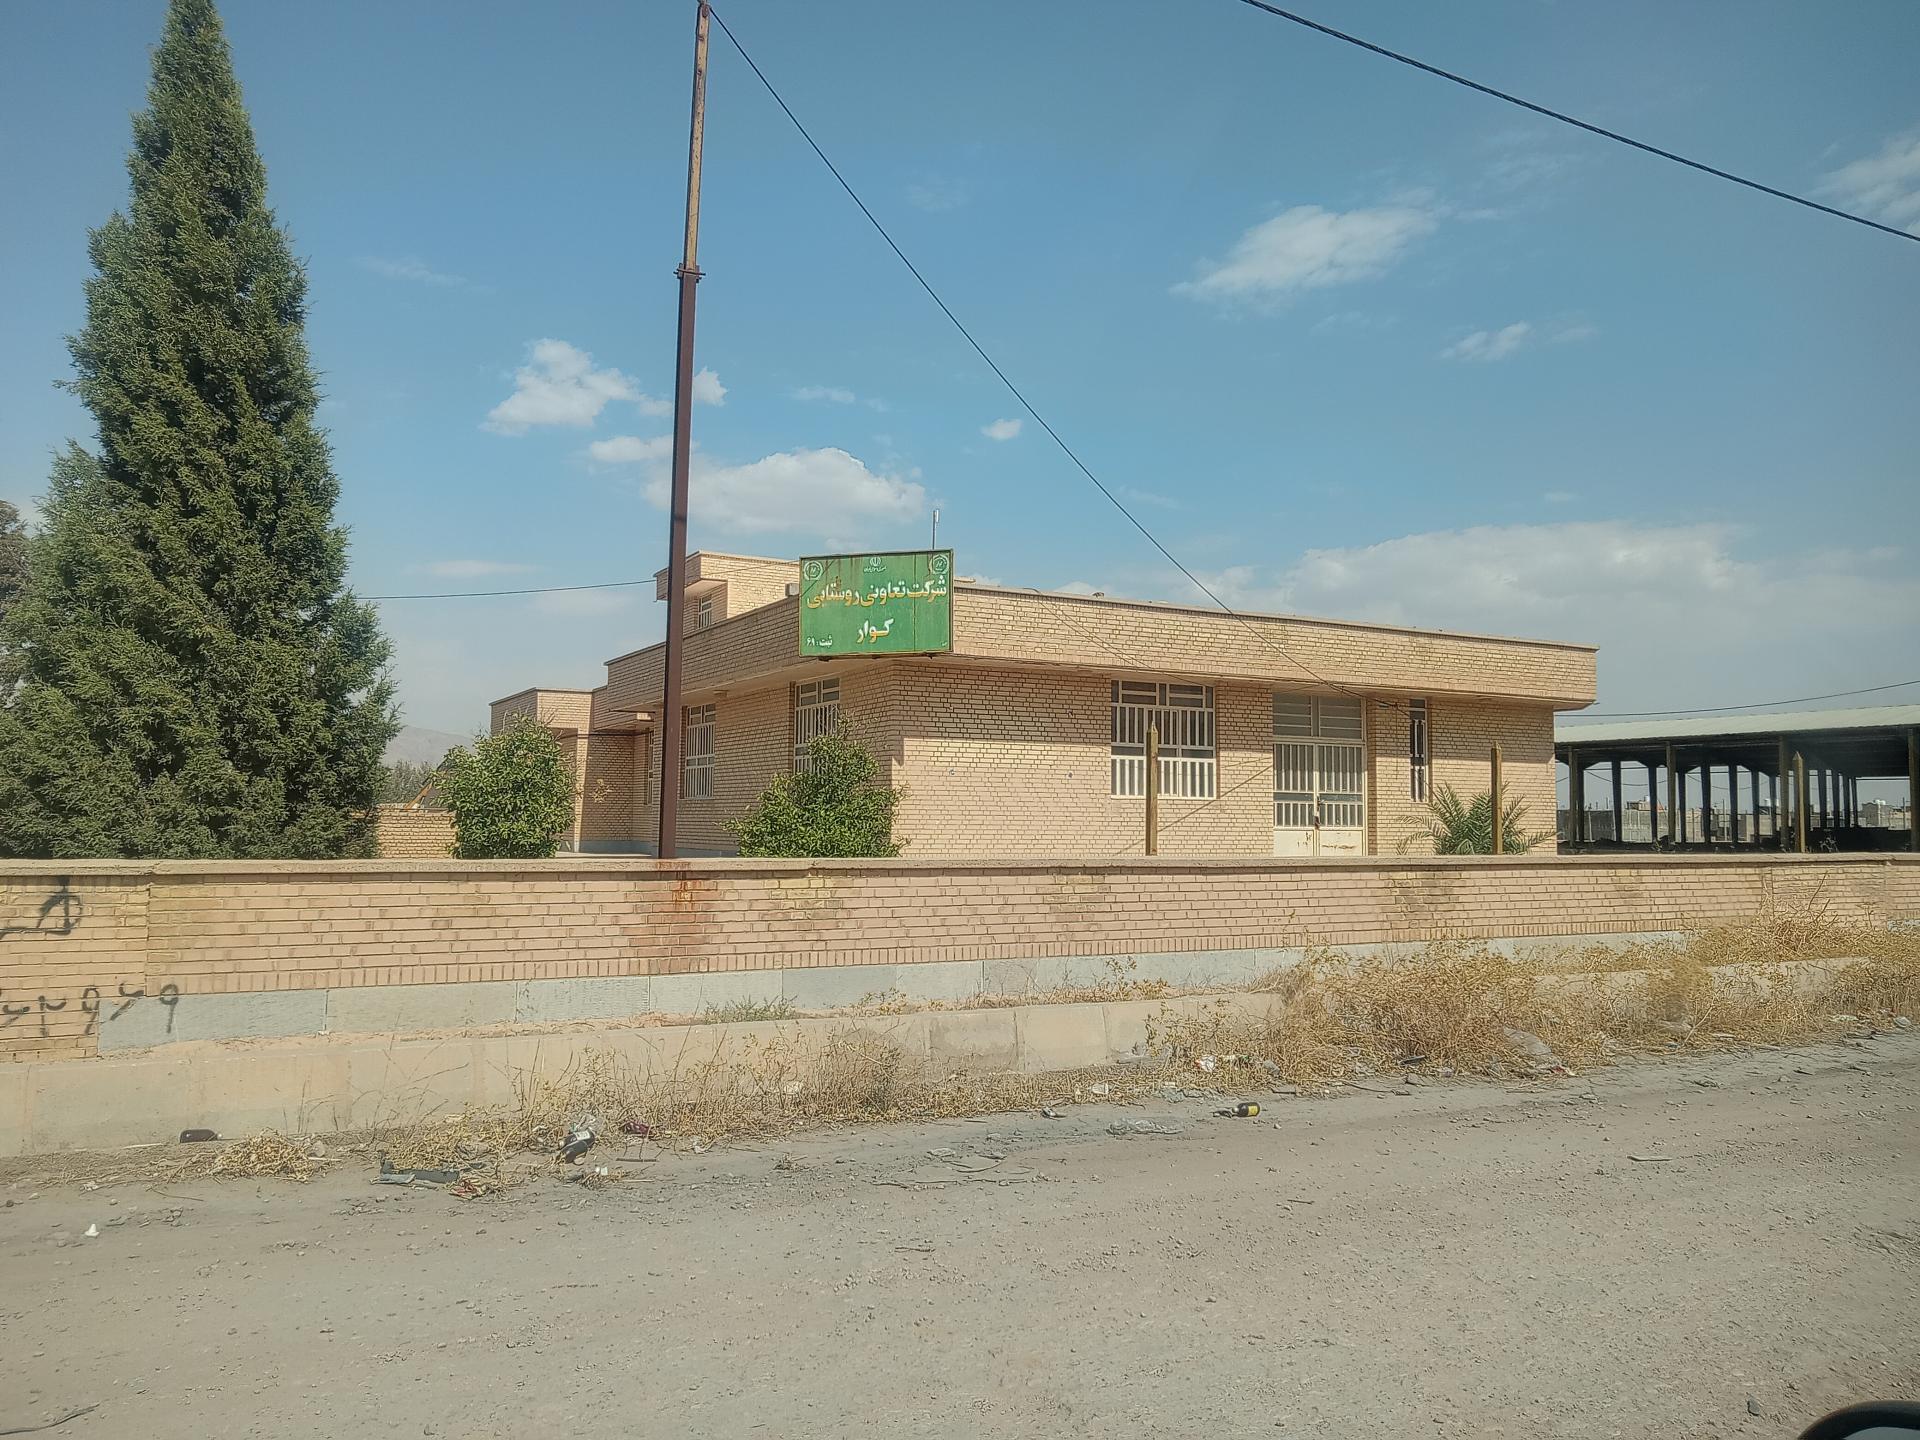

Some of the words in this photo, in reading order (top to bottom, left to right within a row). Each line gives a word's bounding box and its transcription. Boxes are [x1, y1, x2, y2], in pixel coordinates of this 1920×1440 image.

[806, 582, 860, 609] روستایی
[860, 580, 906, 607] تعاونی
[906, 575, 947, 603] شرکت
[856, 618, 895, 644] کوار
